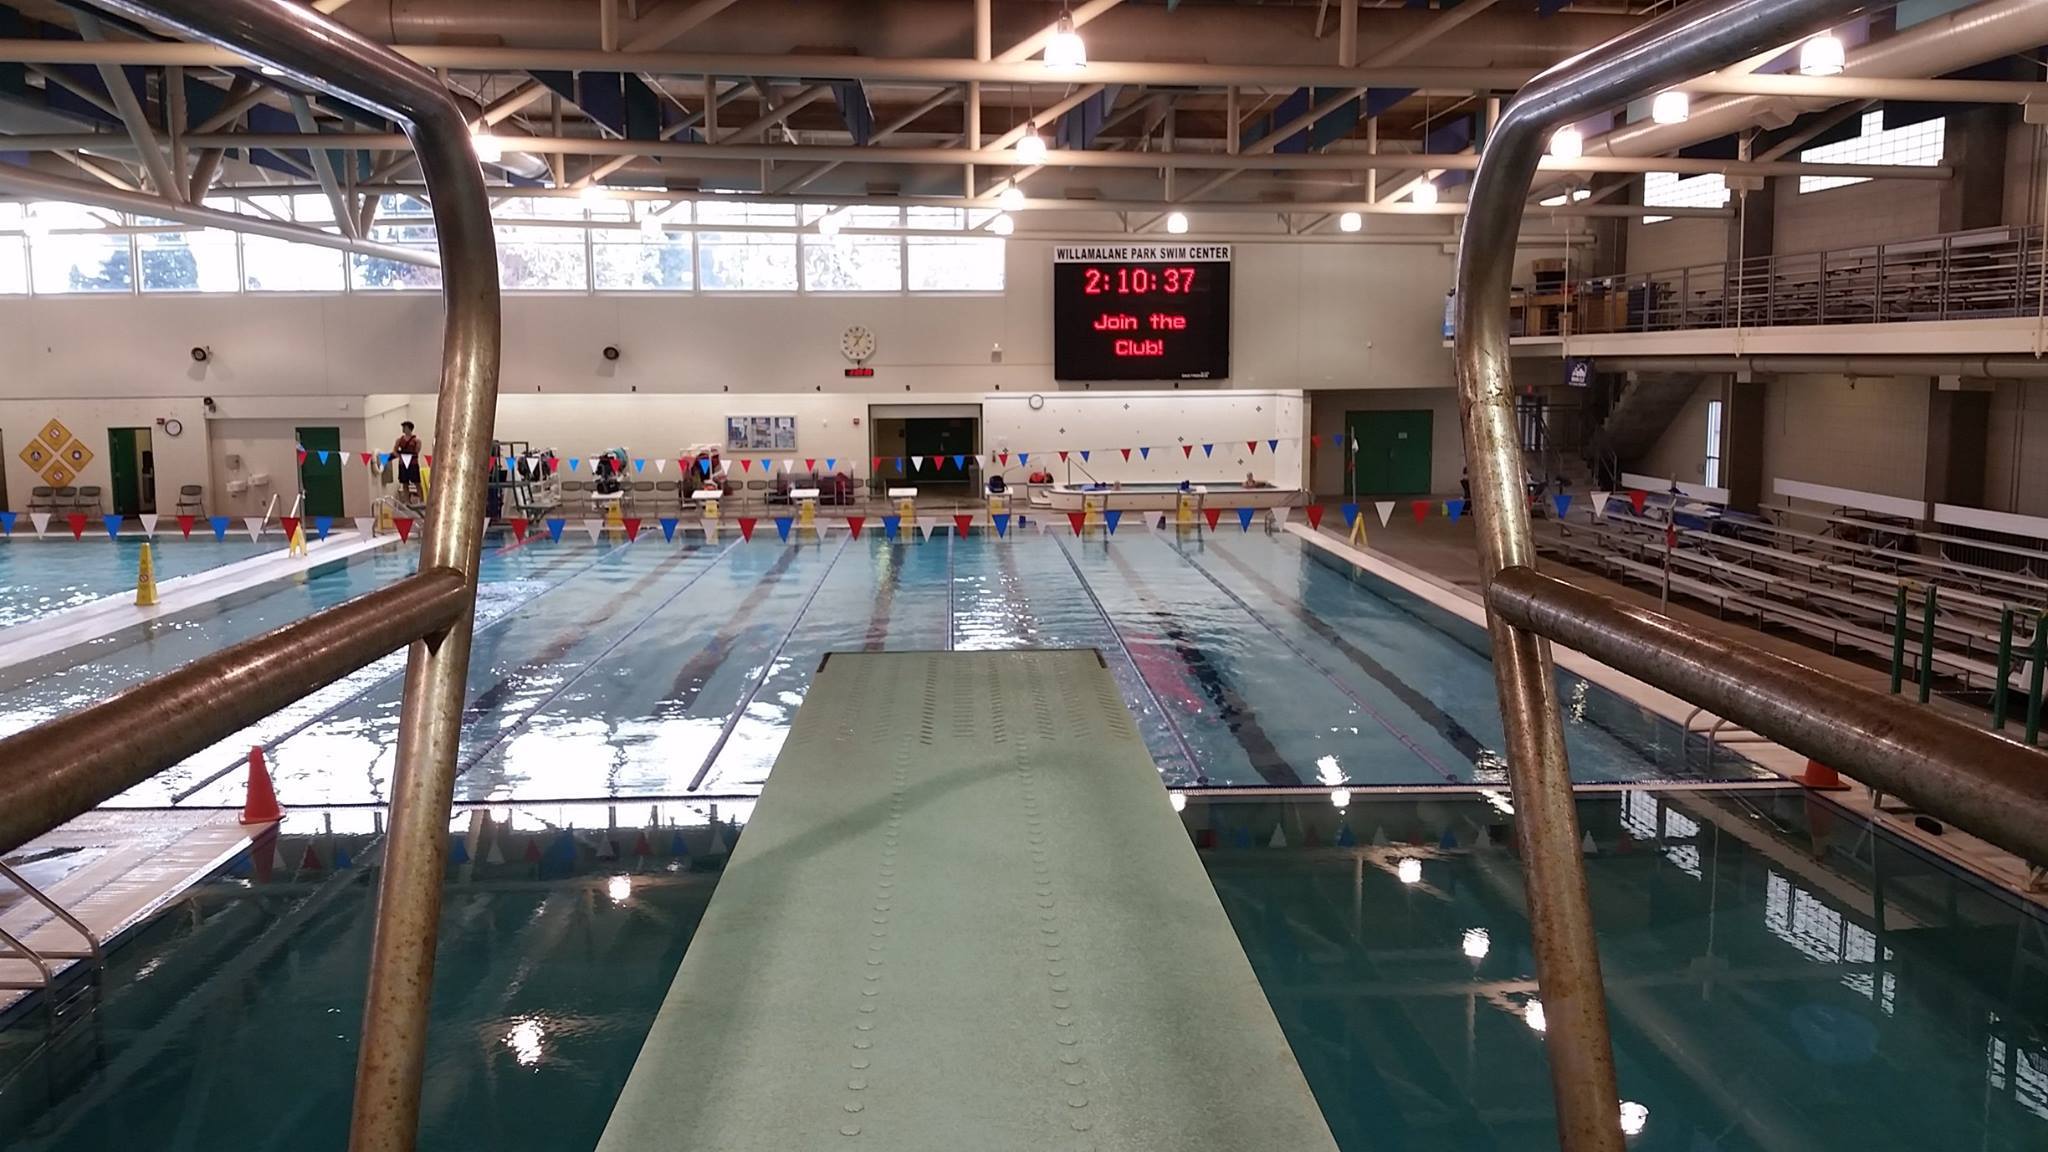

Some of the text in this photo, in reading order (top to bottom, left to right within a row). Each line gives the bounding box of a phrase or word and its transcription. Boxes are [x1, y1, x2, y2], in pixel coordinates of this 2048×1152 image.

[1057, 247, 1229, 260] WILLAMALANE PARK SWIM CENTER
[1085, 268, 1195, 294] 2:10:37
[1094, 314, 1186, 330] Join the
[1115, 339, 1163, 356] Club!
